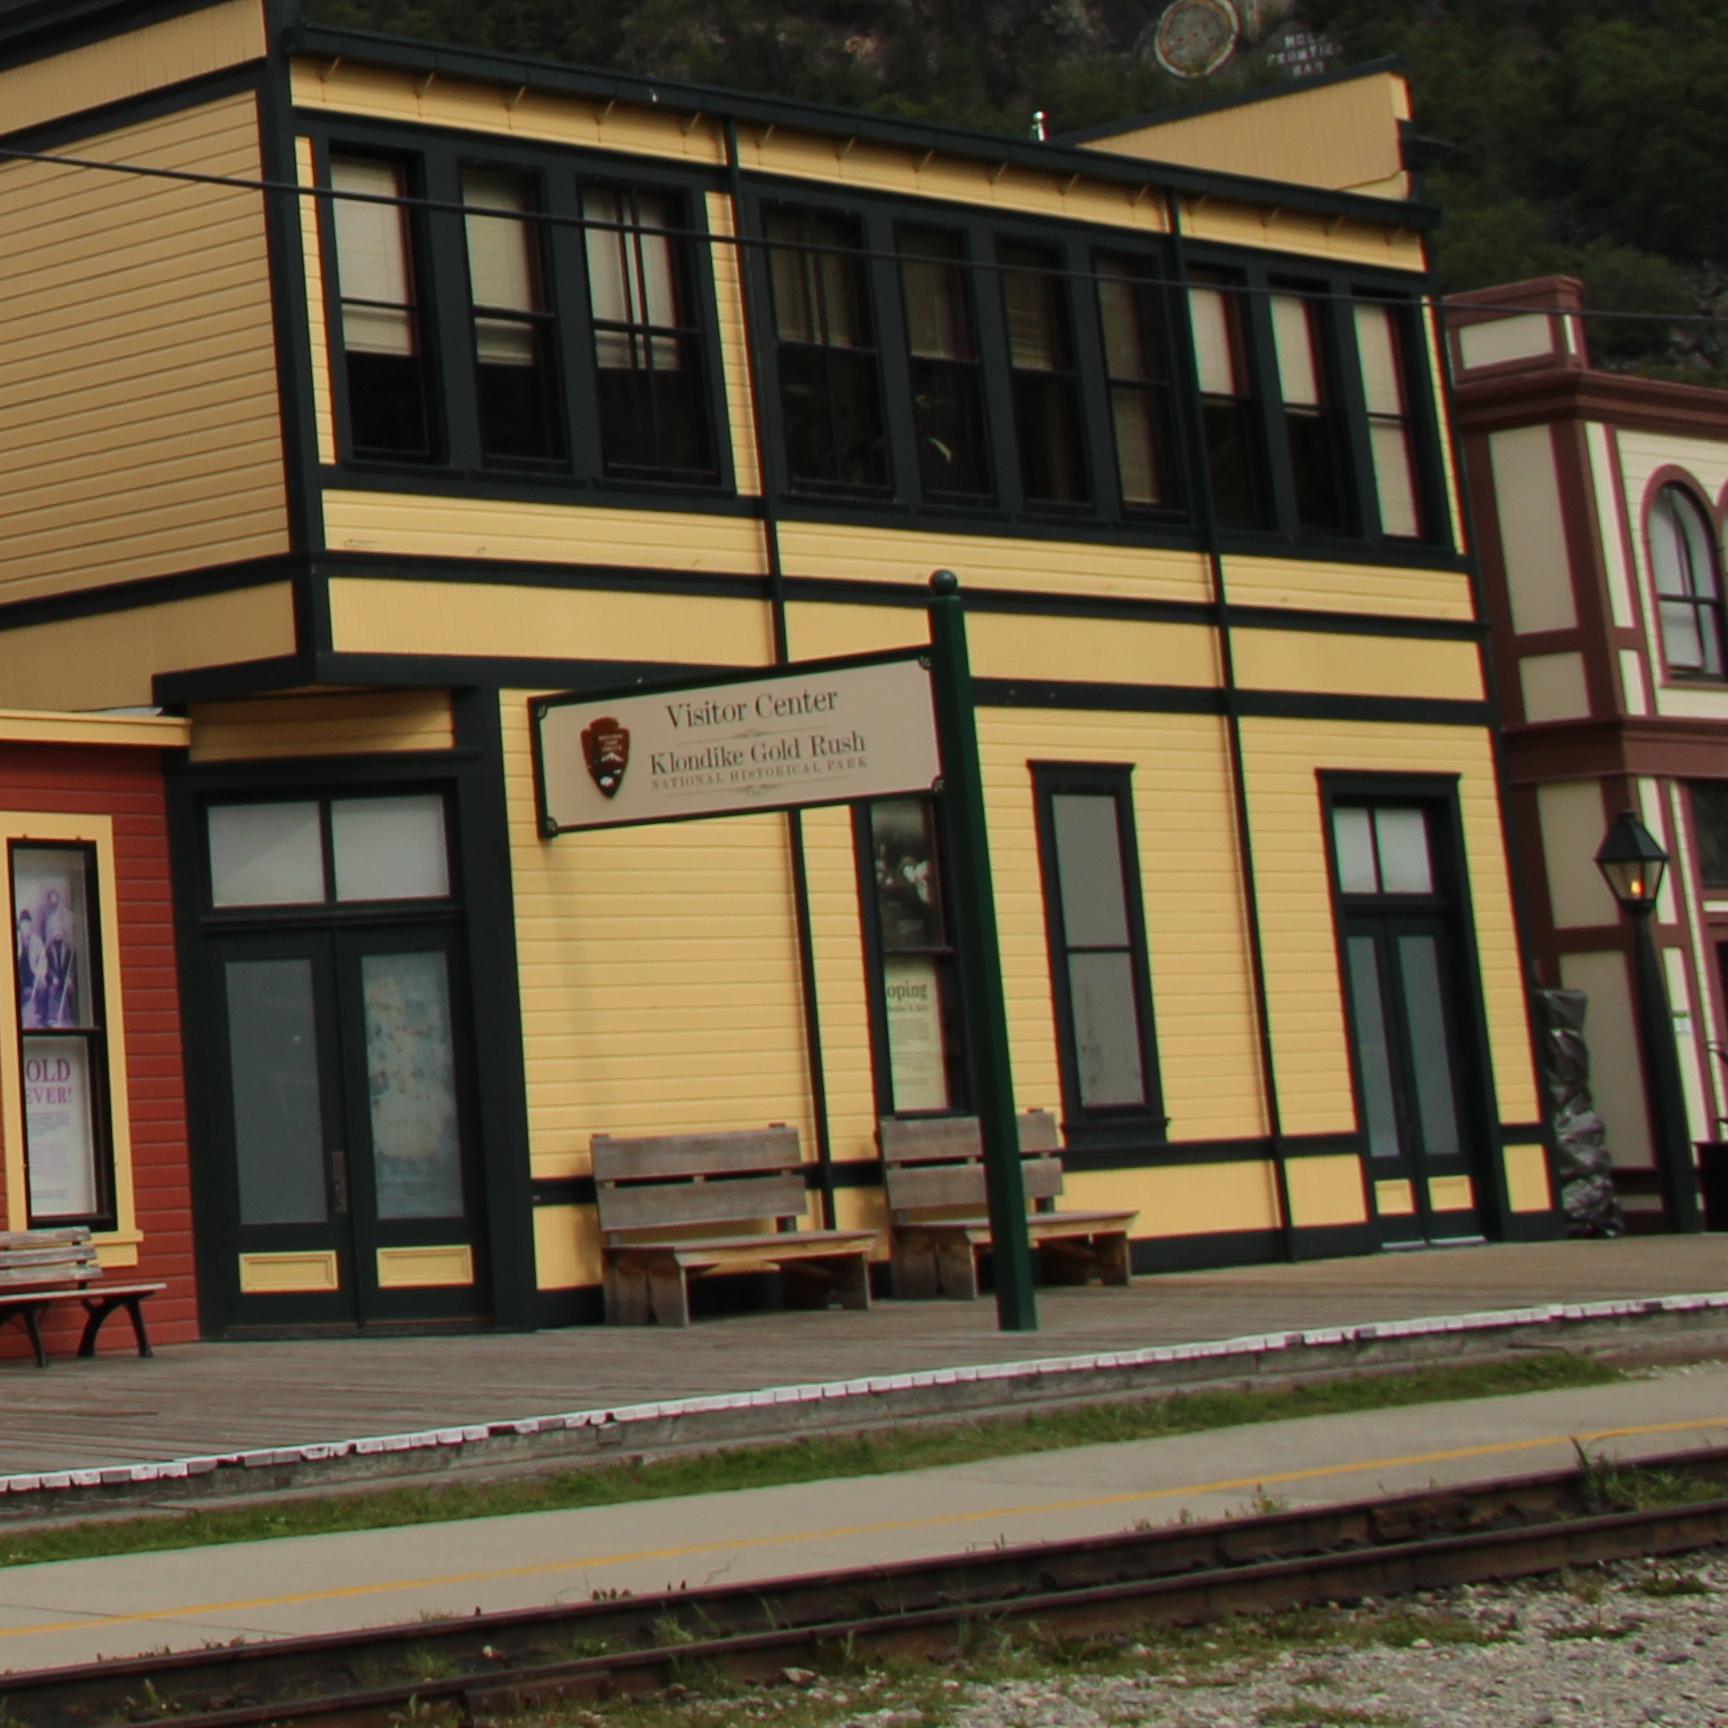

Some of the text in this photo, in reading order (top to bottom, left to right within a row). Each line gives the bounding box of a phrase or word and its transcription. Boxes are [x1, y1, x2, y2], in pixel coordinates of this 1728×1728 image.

[665, 689, 838, 729] Visitor Center
[649, 730, 866, 775] Klondike Gold Rush
[651, 756, 868, 791] NATIONAL HISTORICAL PARK
